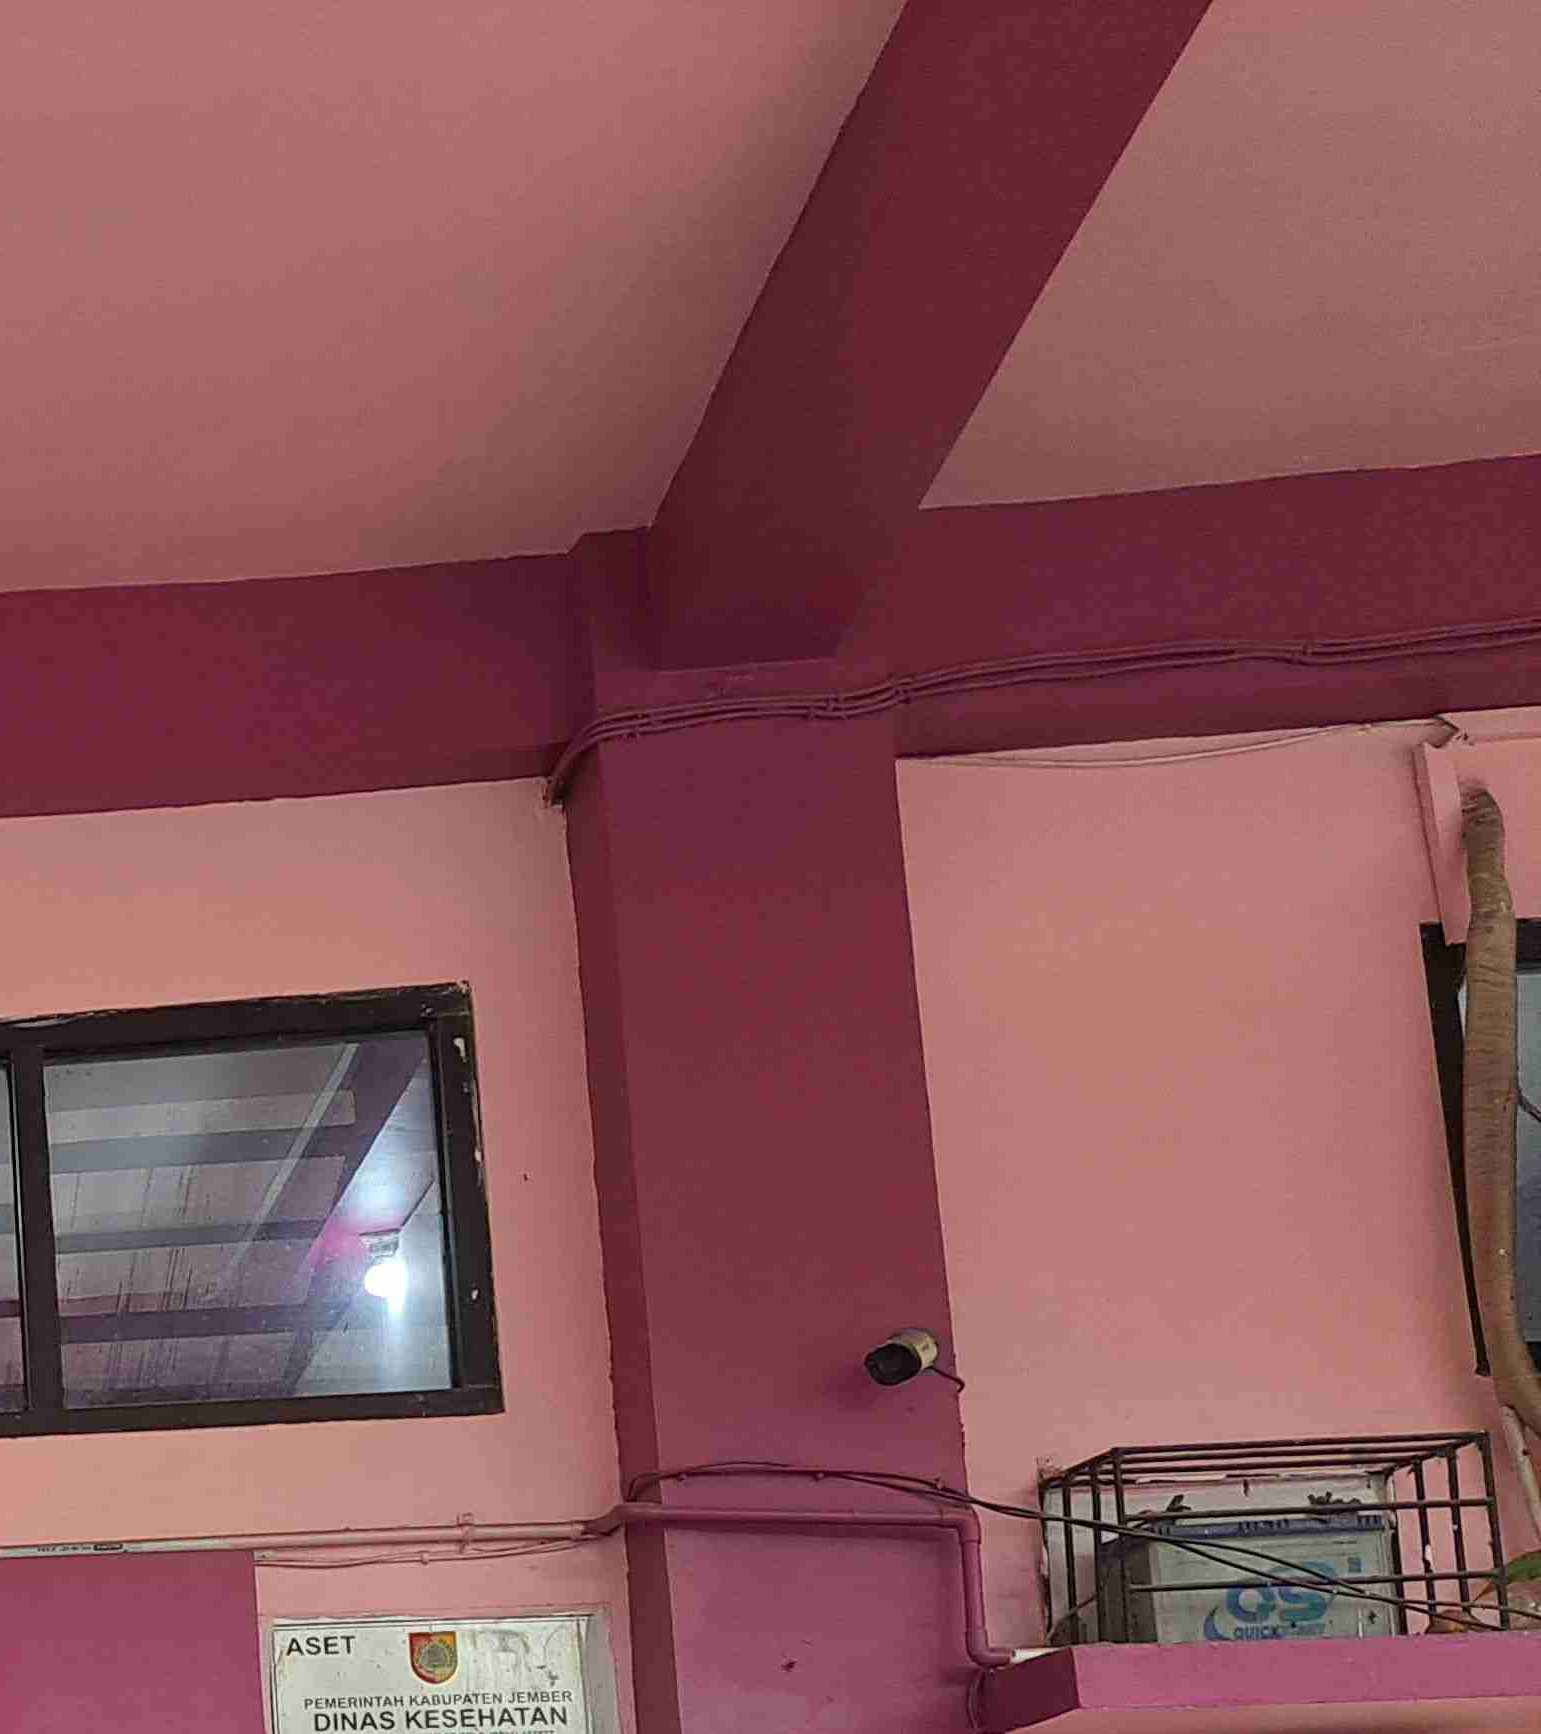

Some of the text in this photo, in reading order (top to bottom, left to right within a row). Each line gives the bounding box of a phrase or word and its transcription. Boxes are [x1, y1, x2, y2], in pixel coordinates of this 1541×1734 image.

[286, 1636, 356, 1656] ASET
[304, 1690, 573, 1710] PEMERINTAH KABUPATEN JEMBER
[314, 1706, 568, 1732] DINAS KESEHATAN
